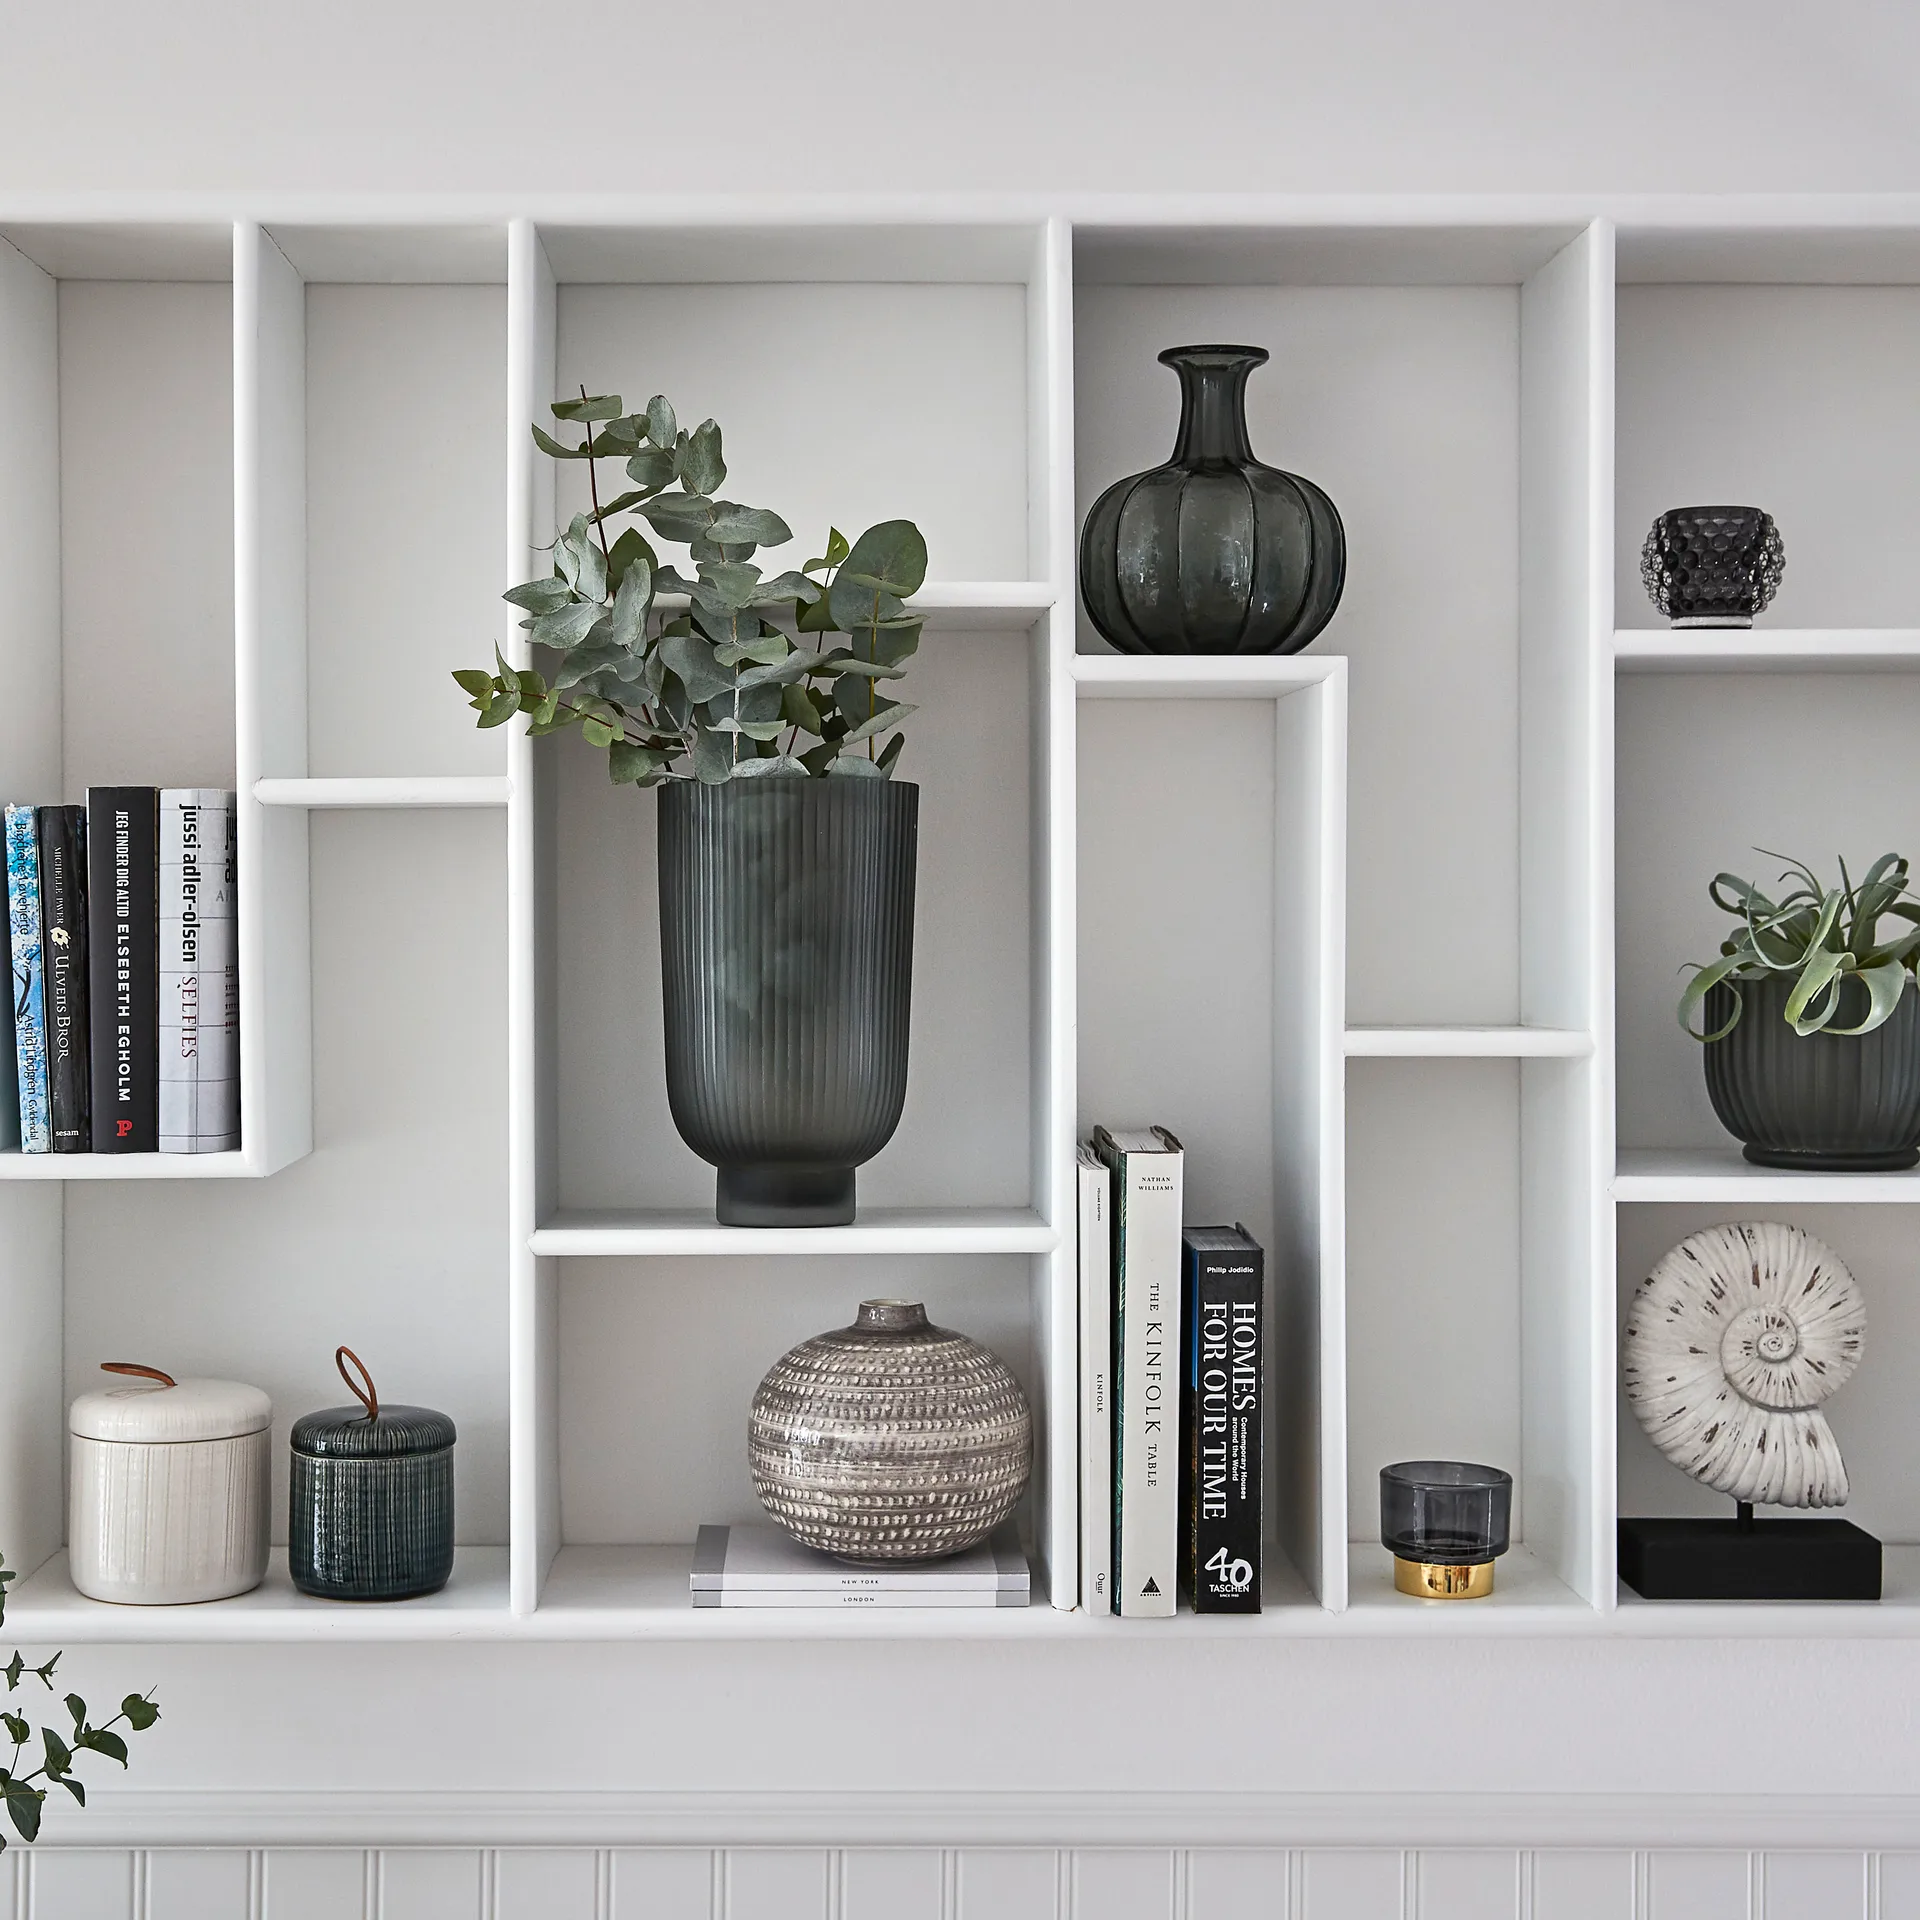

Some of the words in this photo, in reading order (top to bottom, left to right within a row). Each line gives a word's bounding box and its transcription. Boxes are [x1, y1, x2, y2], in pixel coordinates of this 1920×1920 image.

[115, 811, 130, 829] JEG
[179, 803, 202, 848] jussi
[15, 823, 29, 872] Brødrene
[53, 846, 63, 894] MICHELLE
[115, 830, 130, 866] FINDER
[116, 868, 130, 887] DIG
[55, 897, 65, 924] PAVER
[116, 888, 130, 917] ALTID
[182, 854, 202, 963] adler-olsen
[117, 924, 131, 1017] ELSEBETH
[24, 1014, 38, 1046] Astrid
[181, 976, 198, 1058] SELFIES
[23, 1049, 39, 1094] Lindgren
[117, 1025, 132, 1102] EGHOLM
[27, 1099, 40, 1140] Gyldendal
[1206, 1267, 1226, 1276] Philip
[1228, 1267, 1254, 1275] Jodidio
[1149, 1283, 1160, 1311] THE
[1203, 1301, 1228, 1363] FOR
[1144, 1322, 1162, 1435] KINFOLK
[1232, 1301, 1256, 1411] HOMES
[1203, 1368, 1228, 1435] OUR
[1146, 1444, 1157, 1488] TABLE
[1238, 1417, 1248, 1470] Contemporary
[1203, 1441, 1228, 1520] TIME
[1240, 1471, 1248, 1500] Houses
[1209, 1584, 1249, 1592] TASCHEN
